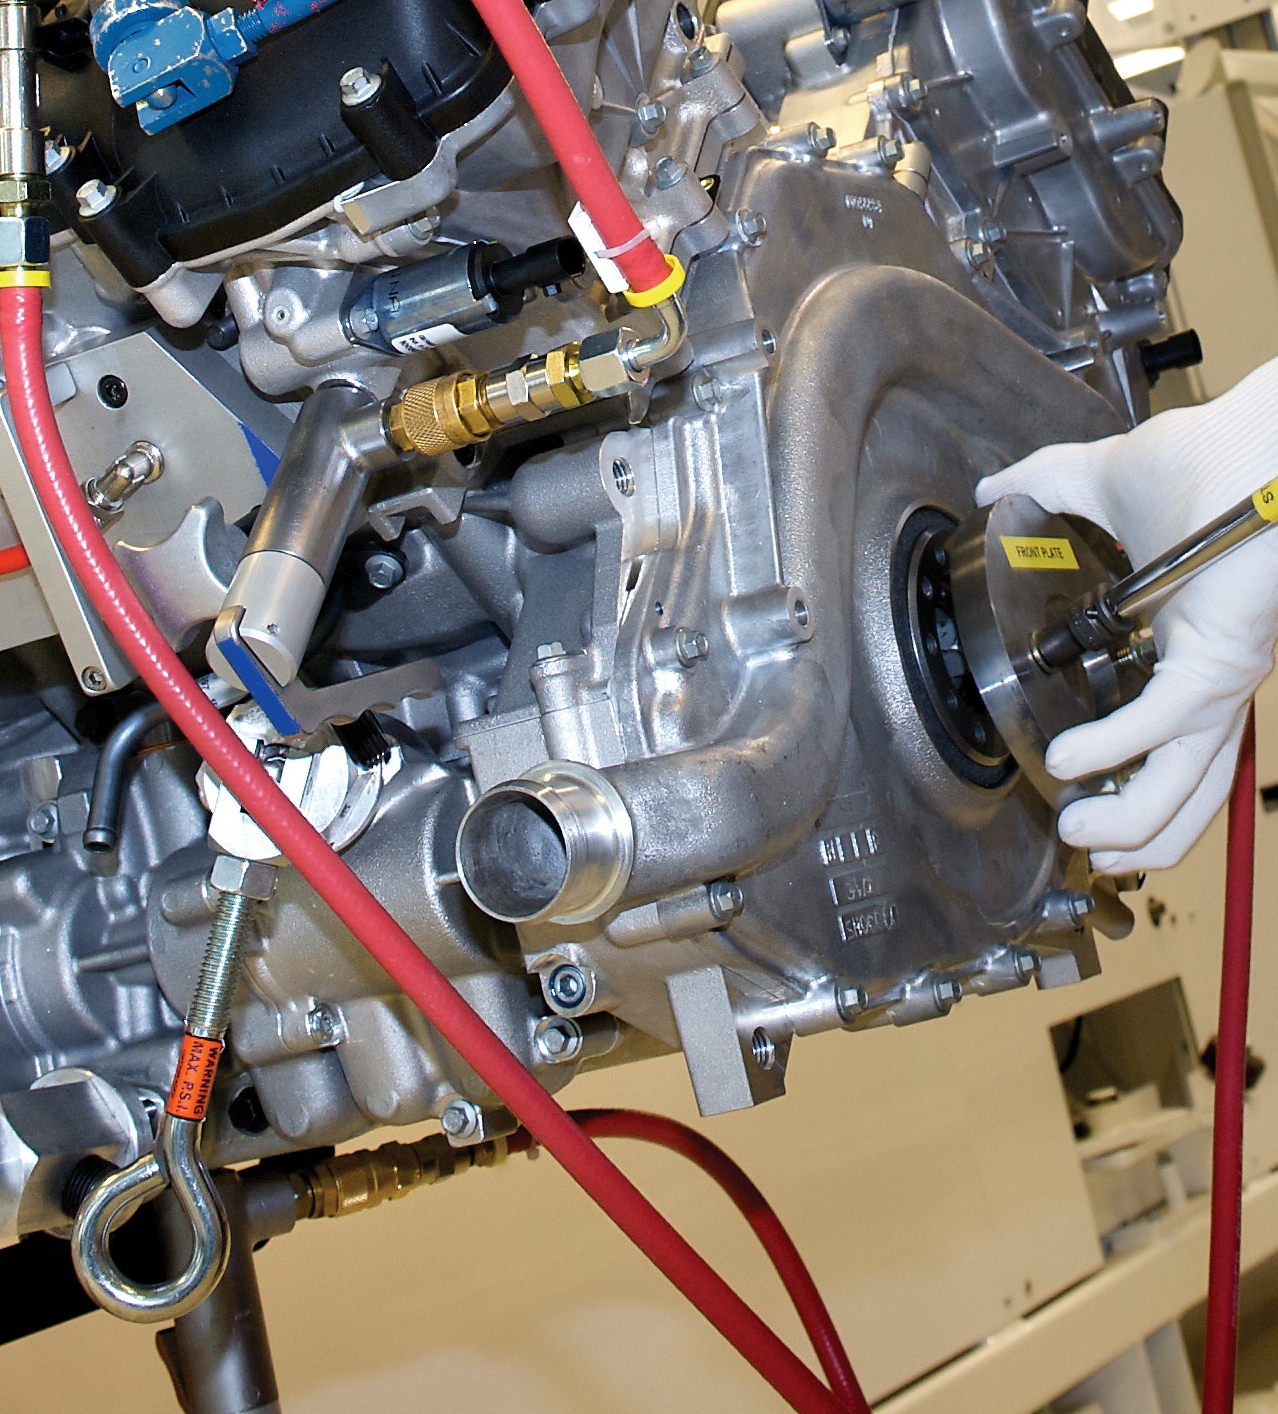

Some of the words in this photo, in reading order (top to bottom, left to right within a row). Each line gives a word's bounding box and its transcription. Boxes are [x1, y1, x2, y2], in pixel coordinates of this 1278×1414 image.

[1015, 545, 1041, 559] FRONT
[1041, 546, 1065, 560] PLATE
[193, 1046, 219, 1115] WARNING
